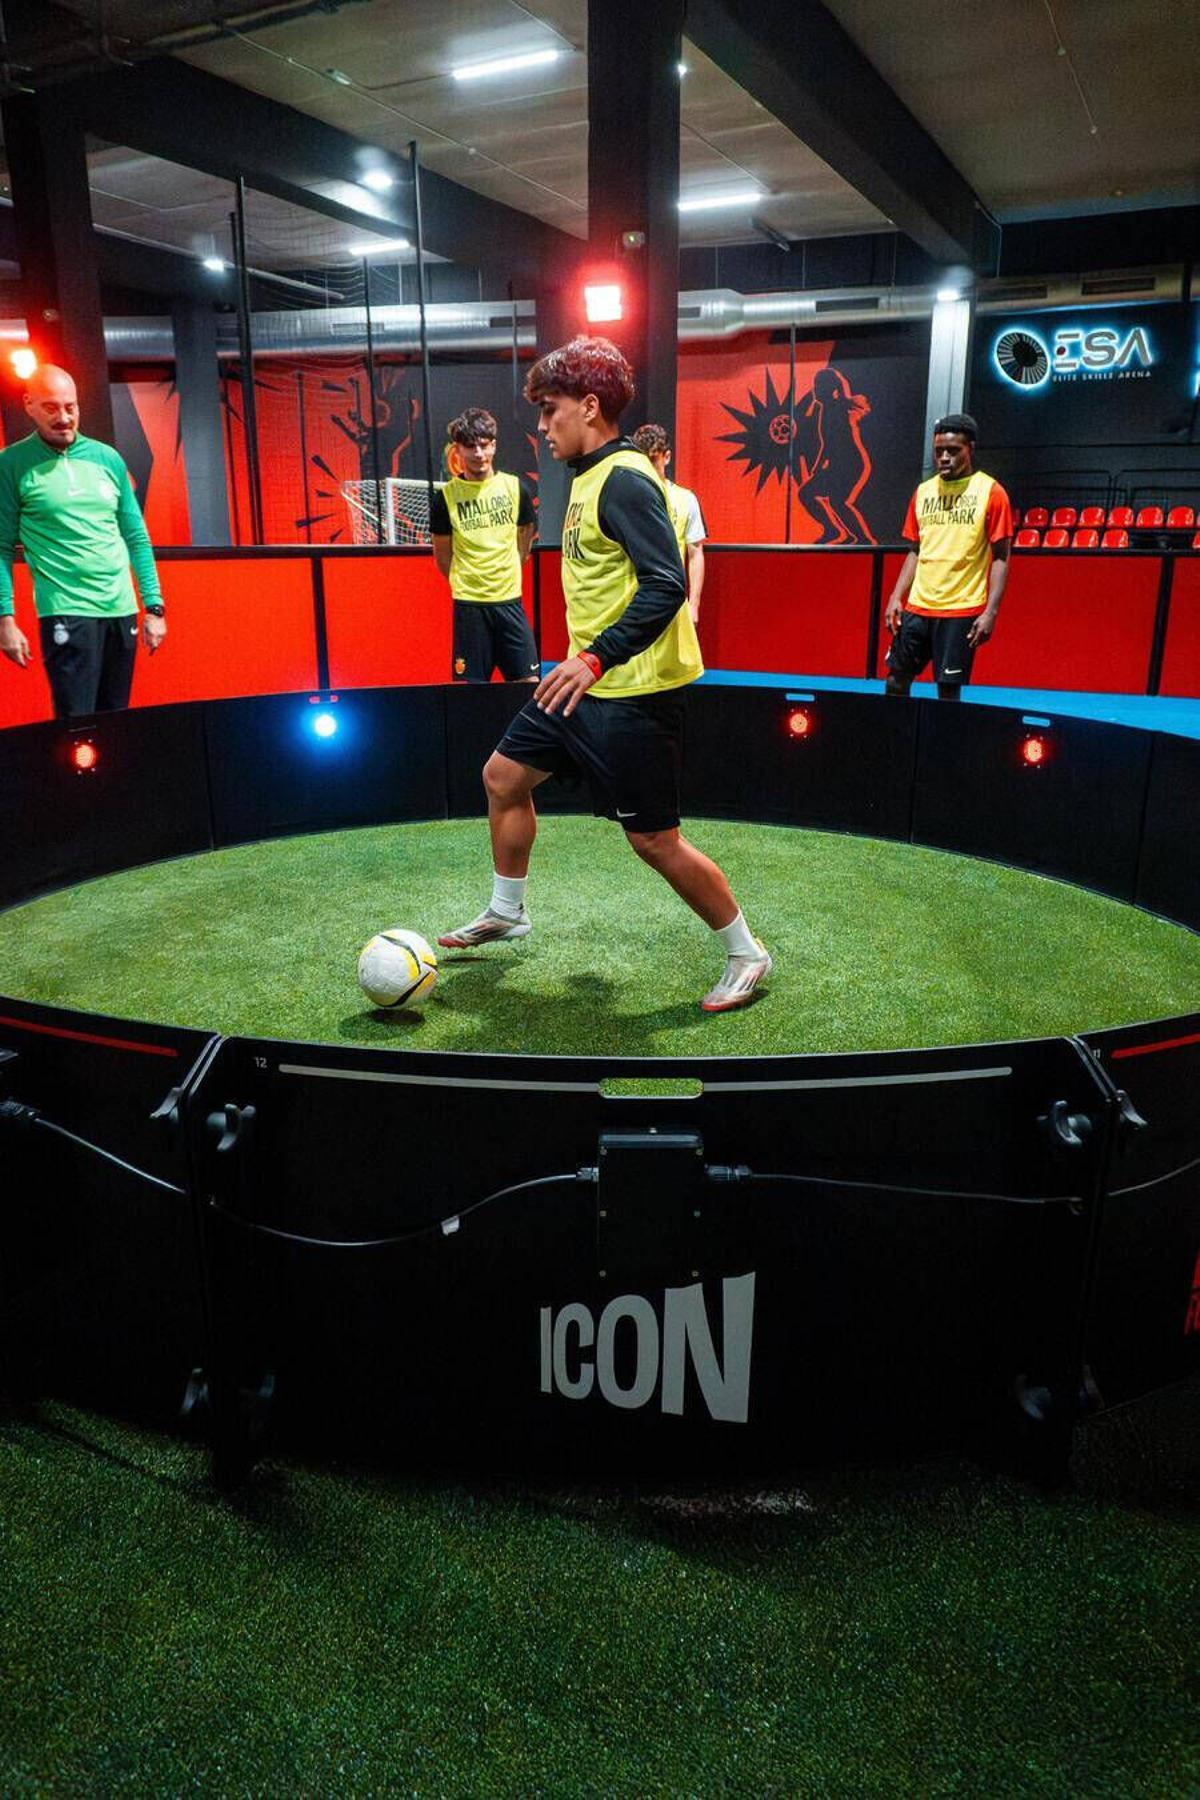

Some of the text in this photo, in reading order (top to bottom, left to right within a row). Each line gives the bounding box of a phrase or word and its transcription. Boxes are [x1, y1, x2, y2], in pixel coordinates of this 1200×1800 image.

[1054, 328, 1152, 371] ESA
[1052, 371, 1152, 382] ELITE SKILLS ARENA
[456, 494, 513, 521] MALLORCA
[489, 508, 514, 527] PARK
[948, 508, 976, 525] PARK
[565, 527, 585, 559] ARK
[253, 1056, 268, 1068] 12
[540, 1271, 756, 1423] ICON
